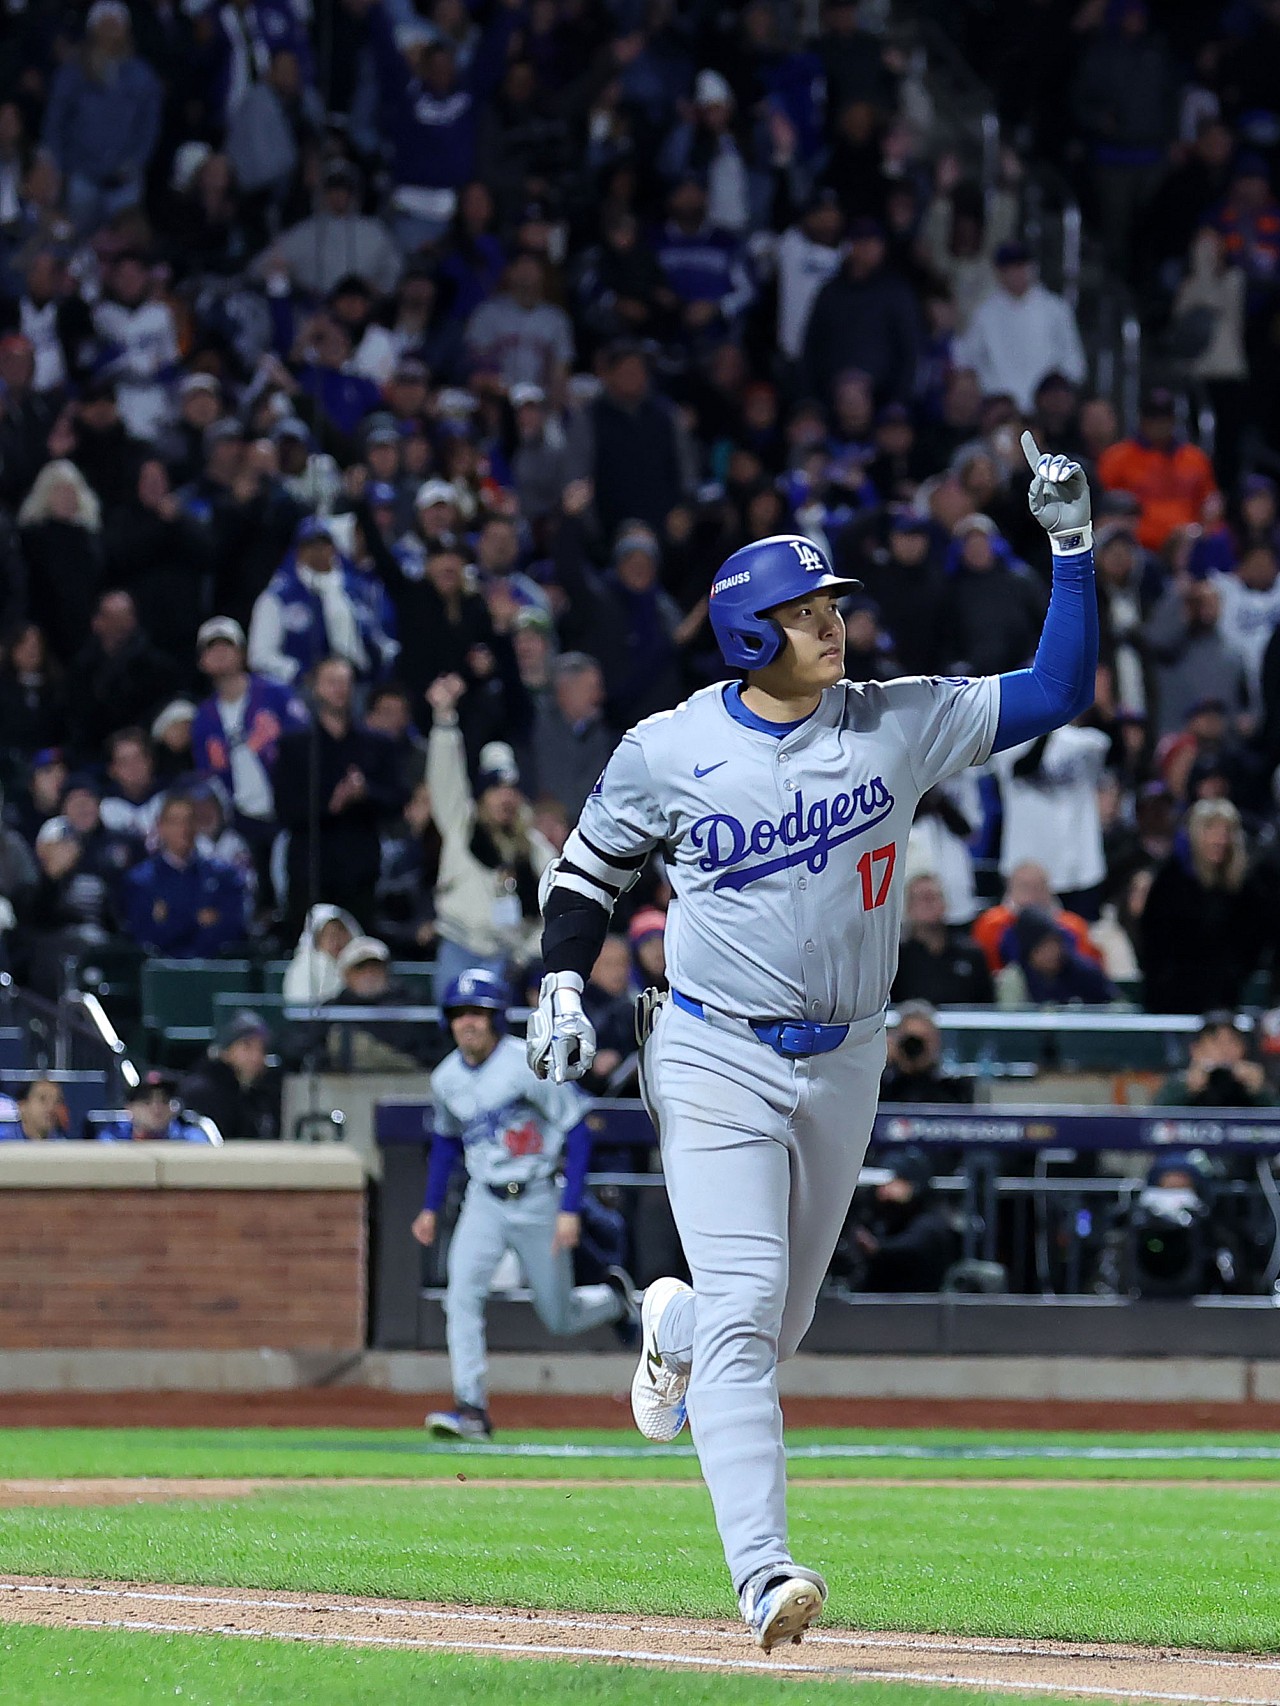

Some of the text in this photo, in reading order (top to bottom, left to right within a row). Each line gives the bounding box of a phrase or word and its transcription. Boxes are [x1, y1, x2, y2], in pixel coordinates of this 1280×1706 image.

[789, 541, 823, 571] LA
[714, 571, 751, 594] STRAUSS
[690, 776, 895, 890] Dodgers
[857, 841, 896, 911] 17
